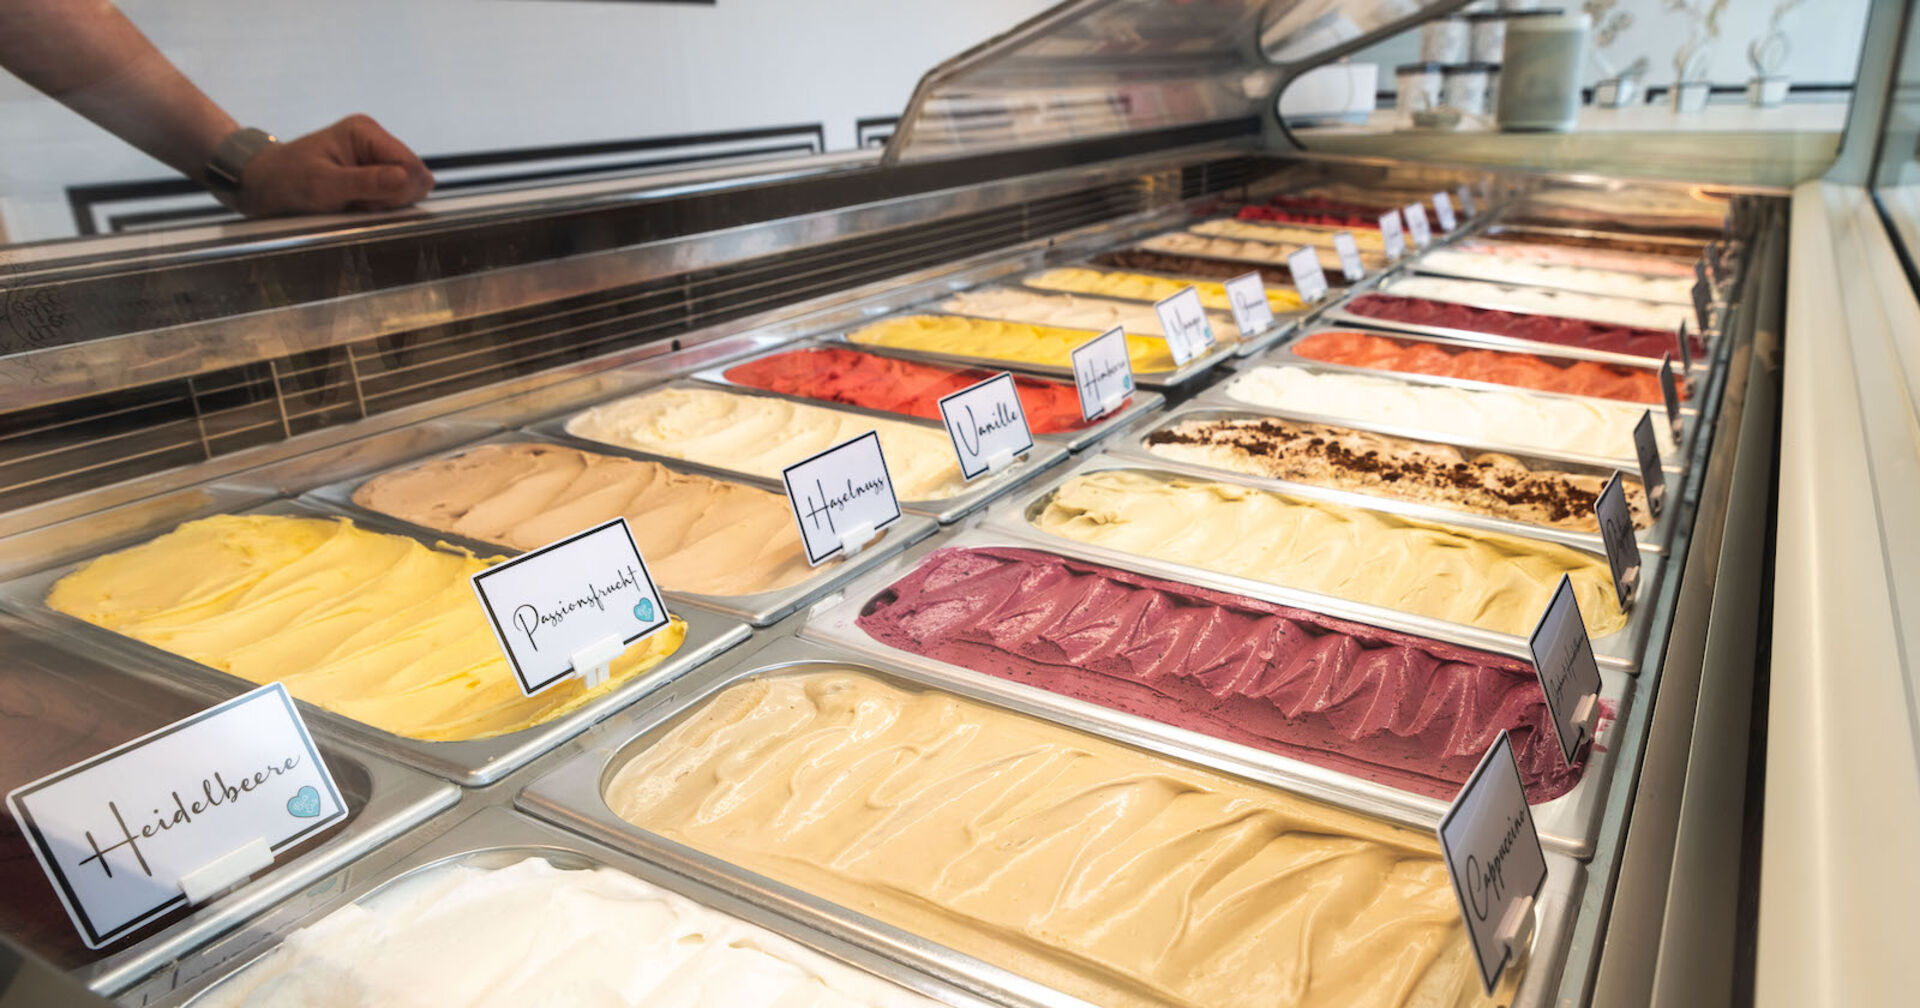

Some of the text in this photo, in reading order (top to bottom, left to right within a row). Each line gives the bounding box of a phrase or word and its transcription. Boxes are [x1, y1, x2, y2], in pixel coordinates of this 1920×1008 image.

[957, 402, 1018, 456] Vanille
[805, 477, 885, 534] Haselnuss
[513, 565, 641, 652] Passionsfrucht
[79, 755, 301, 878] Heidelbeere
[1466, 810, 1525, 921] Cappuccino
